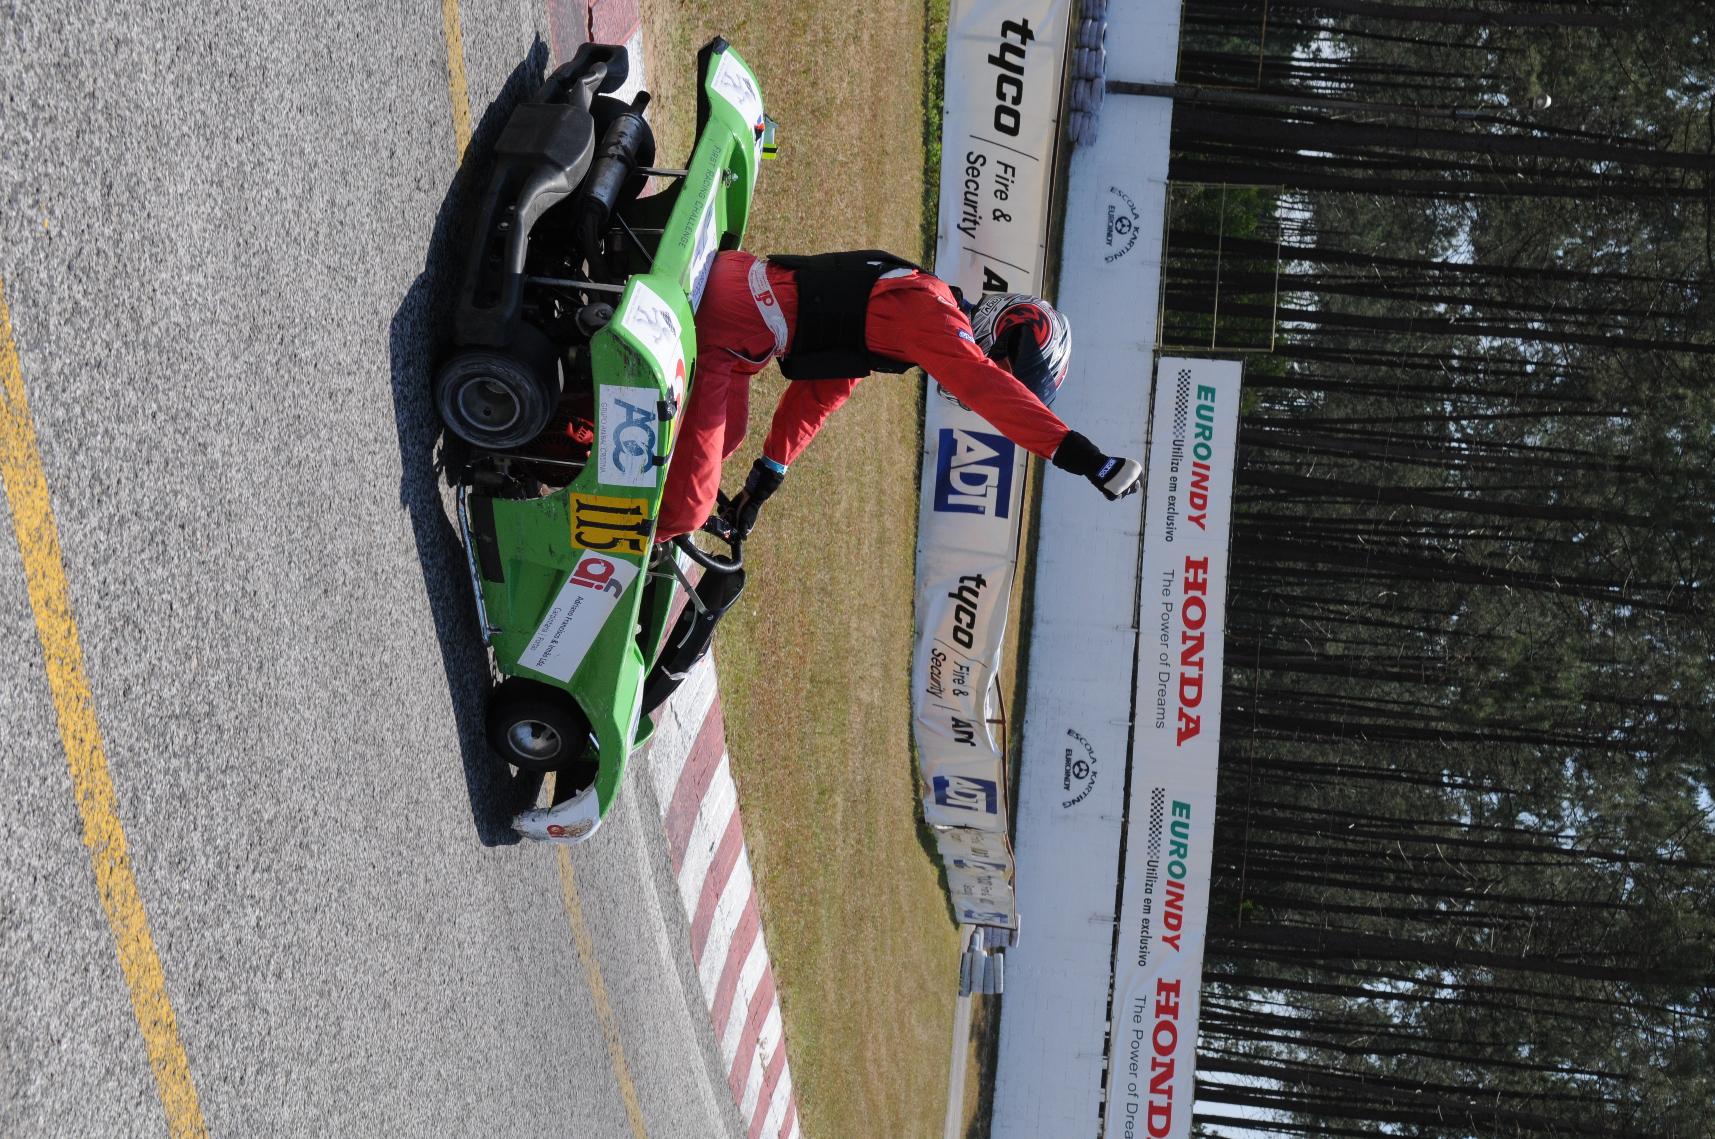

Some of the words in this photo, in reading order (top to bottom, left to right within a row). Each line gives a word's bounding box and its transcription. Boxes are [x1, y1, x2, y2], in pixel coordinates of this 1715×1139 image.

[988, 18, 1036, 137] tyco
[708, 146, 722, 166] FIRST
[698, 168, 715, 198] RACING
[956, 151, 987, 240] Security
[992, 160, 1016, 202] Fire
[992, 208, 1012, 222] &
[1110, 186, 1140, 220] ESCOLA
[678, 200, 704, 249] CHALLENGE
[1106, 204, 1116, 246] EUROINDY
[1105, 226, 1140, 264] KARTING
[600, 402, 608, 424] GRUPO
[947, 429, 1002, 514] ADT
[1170, 438, 1184, 472] Utiliza
[1188, 384, 1216, 530] EUROINDY
[1168, 476, 1179, 492] em
[574, 499, 644, 553] 115
[1164, 496, 1180, 542] exclusivo
[1161, 570, 1175, 597] The
[567, 596, 584, 617] Adriano
[948, 573, 988, 649] tyco
[1160, 602, 1174, 648] Power
[554, 616, 573, 639] Francisco
[1159, 652, 1172, 668] of
[1176, 556, 1209, 747] HONDA
[926, 648, 946, 698] Security
[952, 661, 970, 685] Fire
[952, 688, 969, 696] &
[1156, 672, 1171, 729] Dreams
[1066, 728, 1097, 764] ESCOLA
[1064, 748, 1073, 791] EUROINDY
[944, 776, 987, 812] ADT
[1062, 770, 1098, 808] KARTING
[1144, 860, 1159, 894] Utiliza
[1162, 800, 1191, 953] EUROINDY
[1142, 898, 1154, 914] em
[1138, 918, 1154, 967] exclusivo
[1132, 995, 1147, 1024] The
[1127, 1029, 1144, 1078] Power
[1146, 978, 1181, 1139] HOND
[1126, 1082, 1140, 1098] of
